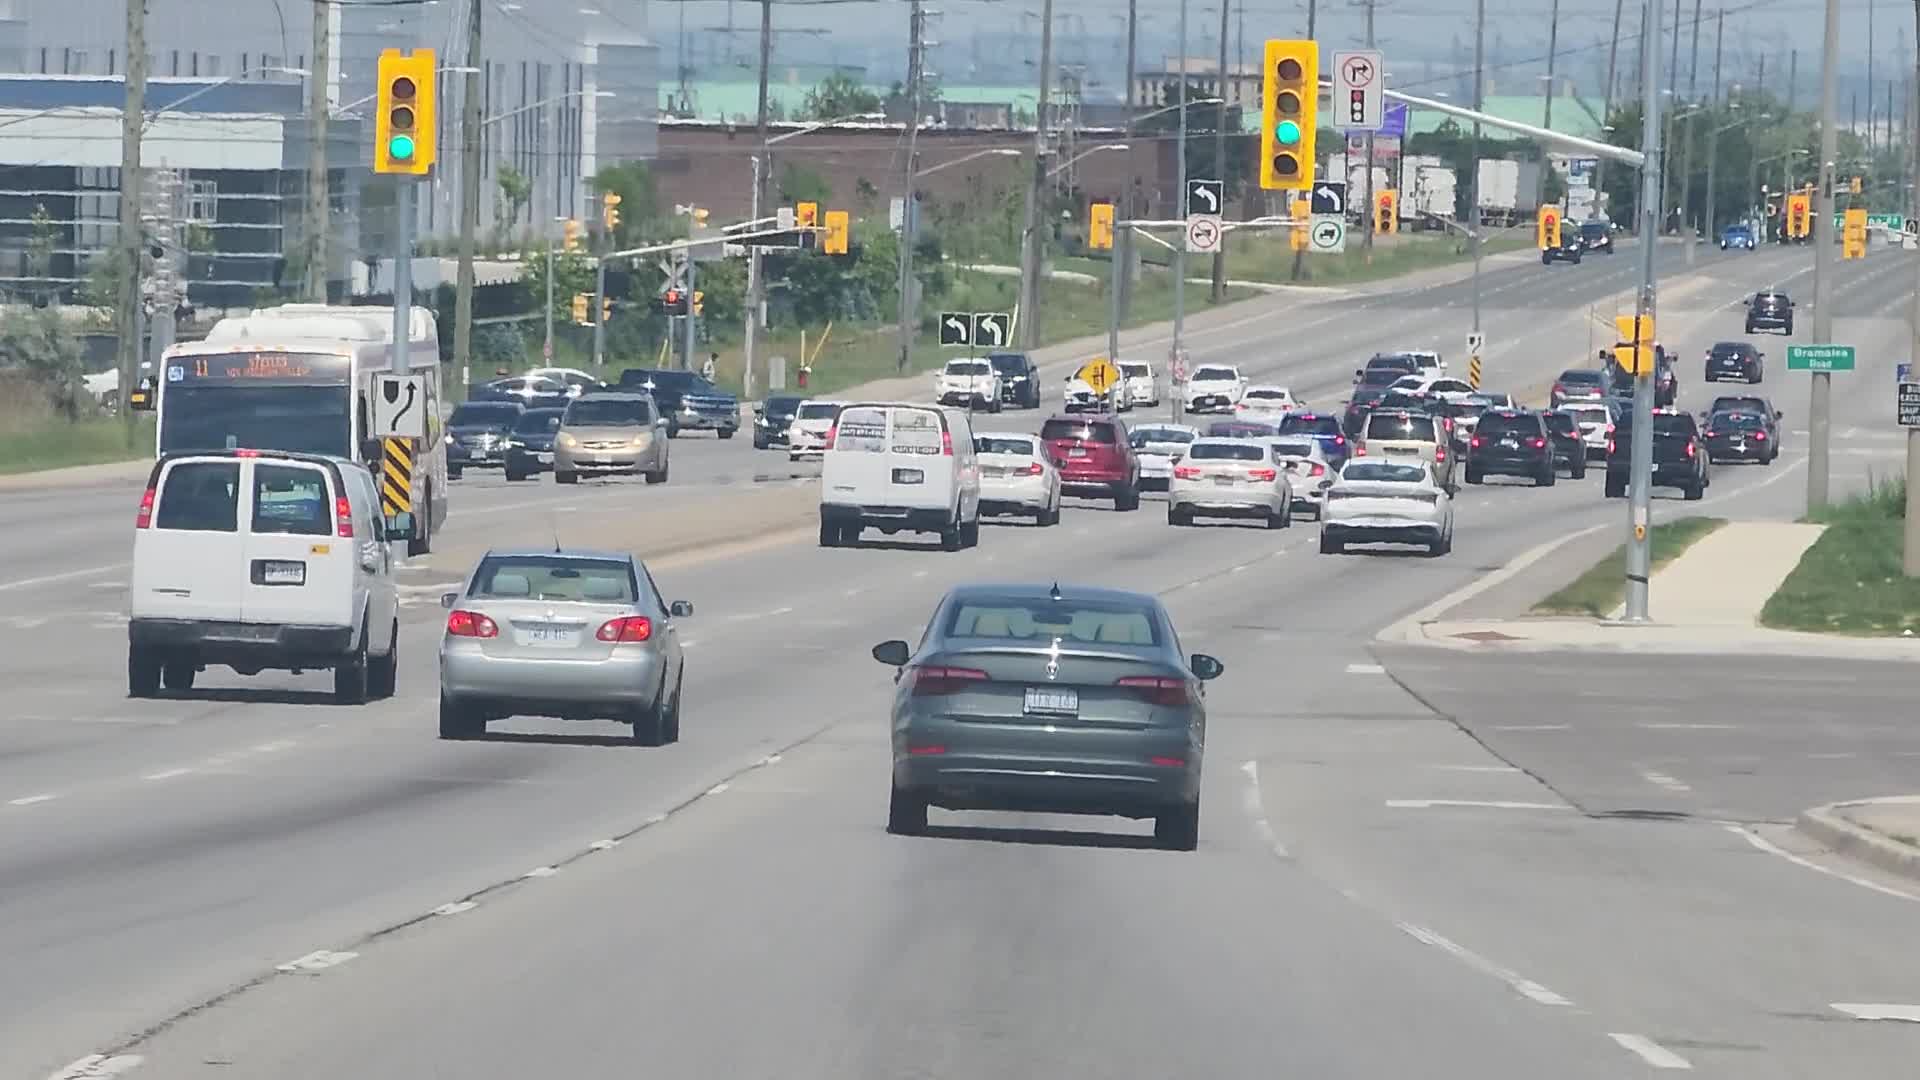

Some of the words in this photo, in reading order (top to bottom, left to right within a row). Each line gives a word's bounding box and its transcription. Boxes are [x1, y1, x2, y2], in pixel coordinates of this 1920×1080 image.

[1794, 347, 1848, 358] Bramalea
[195, 359, 209, 377] 11
[1809, 359, 1833, 369] Road
